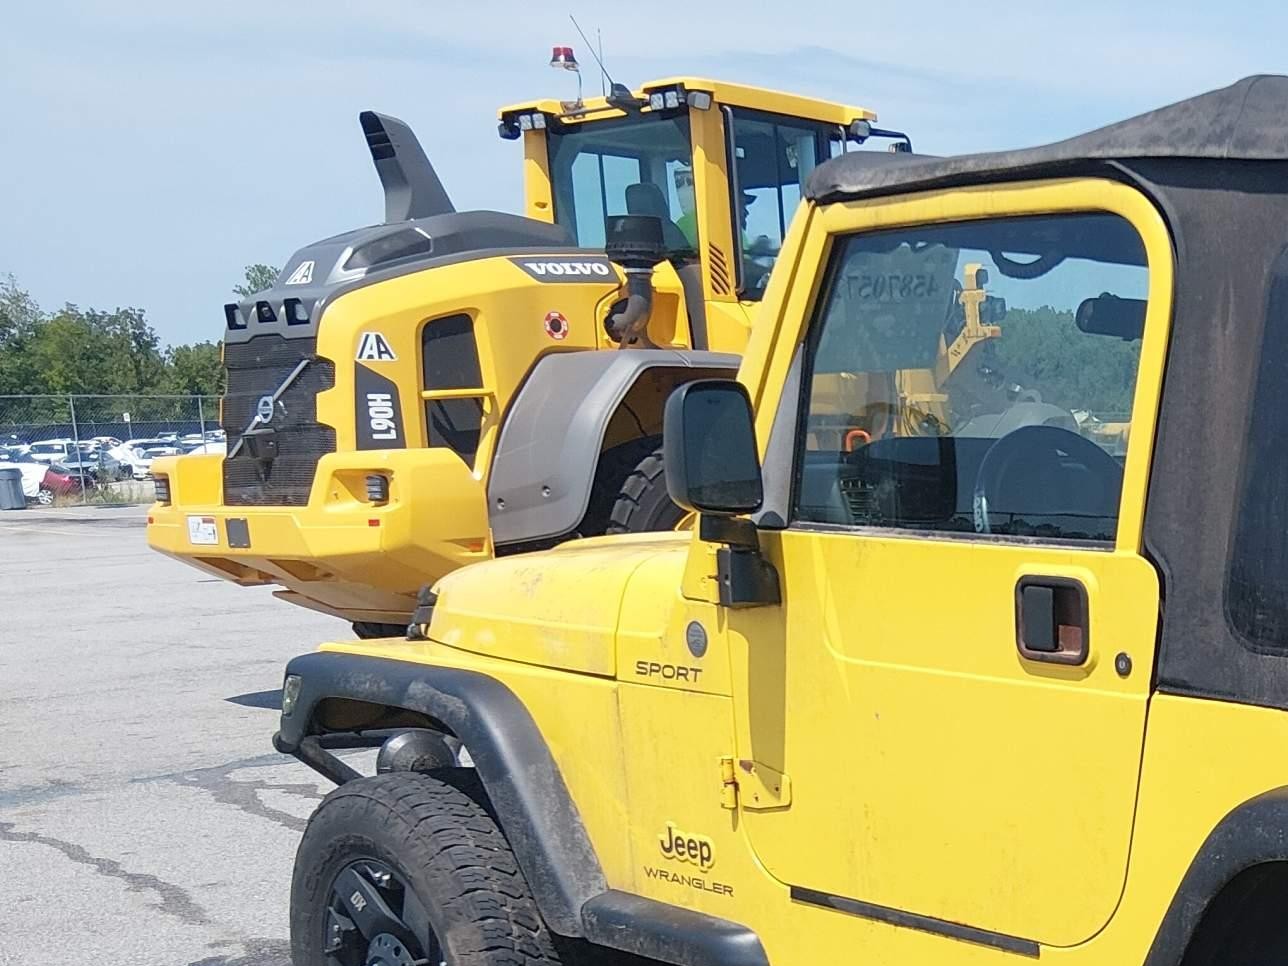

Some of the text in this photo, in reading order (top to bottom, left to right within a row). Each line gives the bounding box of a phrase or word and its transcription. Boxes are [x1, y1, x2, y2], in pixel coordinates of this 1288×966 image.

[524, 262, 609, 275] VOLVO
[366, 393, 397, 440] L90H
[636, 660, 703, 682] SPORT
[660, 826, 711, 867] Jeep
[643, 866, 734, 897] WRANGLER
